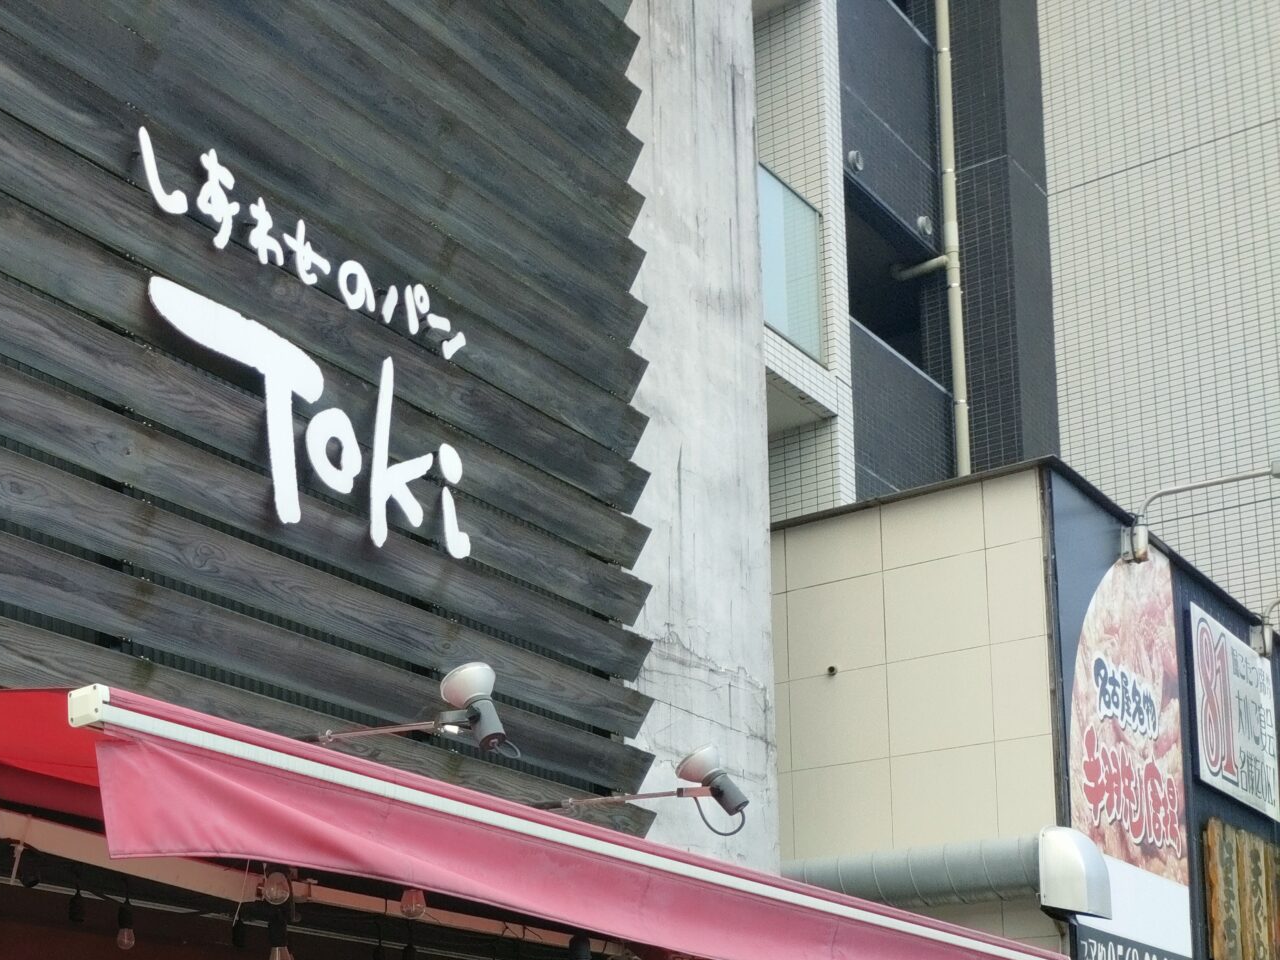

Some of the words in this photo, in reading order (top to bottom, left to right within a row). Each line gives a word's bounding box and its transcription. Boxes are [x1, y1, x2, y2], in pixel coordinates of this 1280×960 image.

[138, 126, 466, 361] しあわせのパン
[148, 276, 471, 560] Toki
[1093, 657, 1158, 737] 名古屋名物
